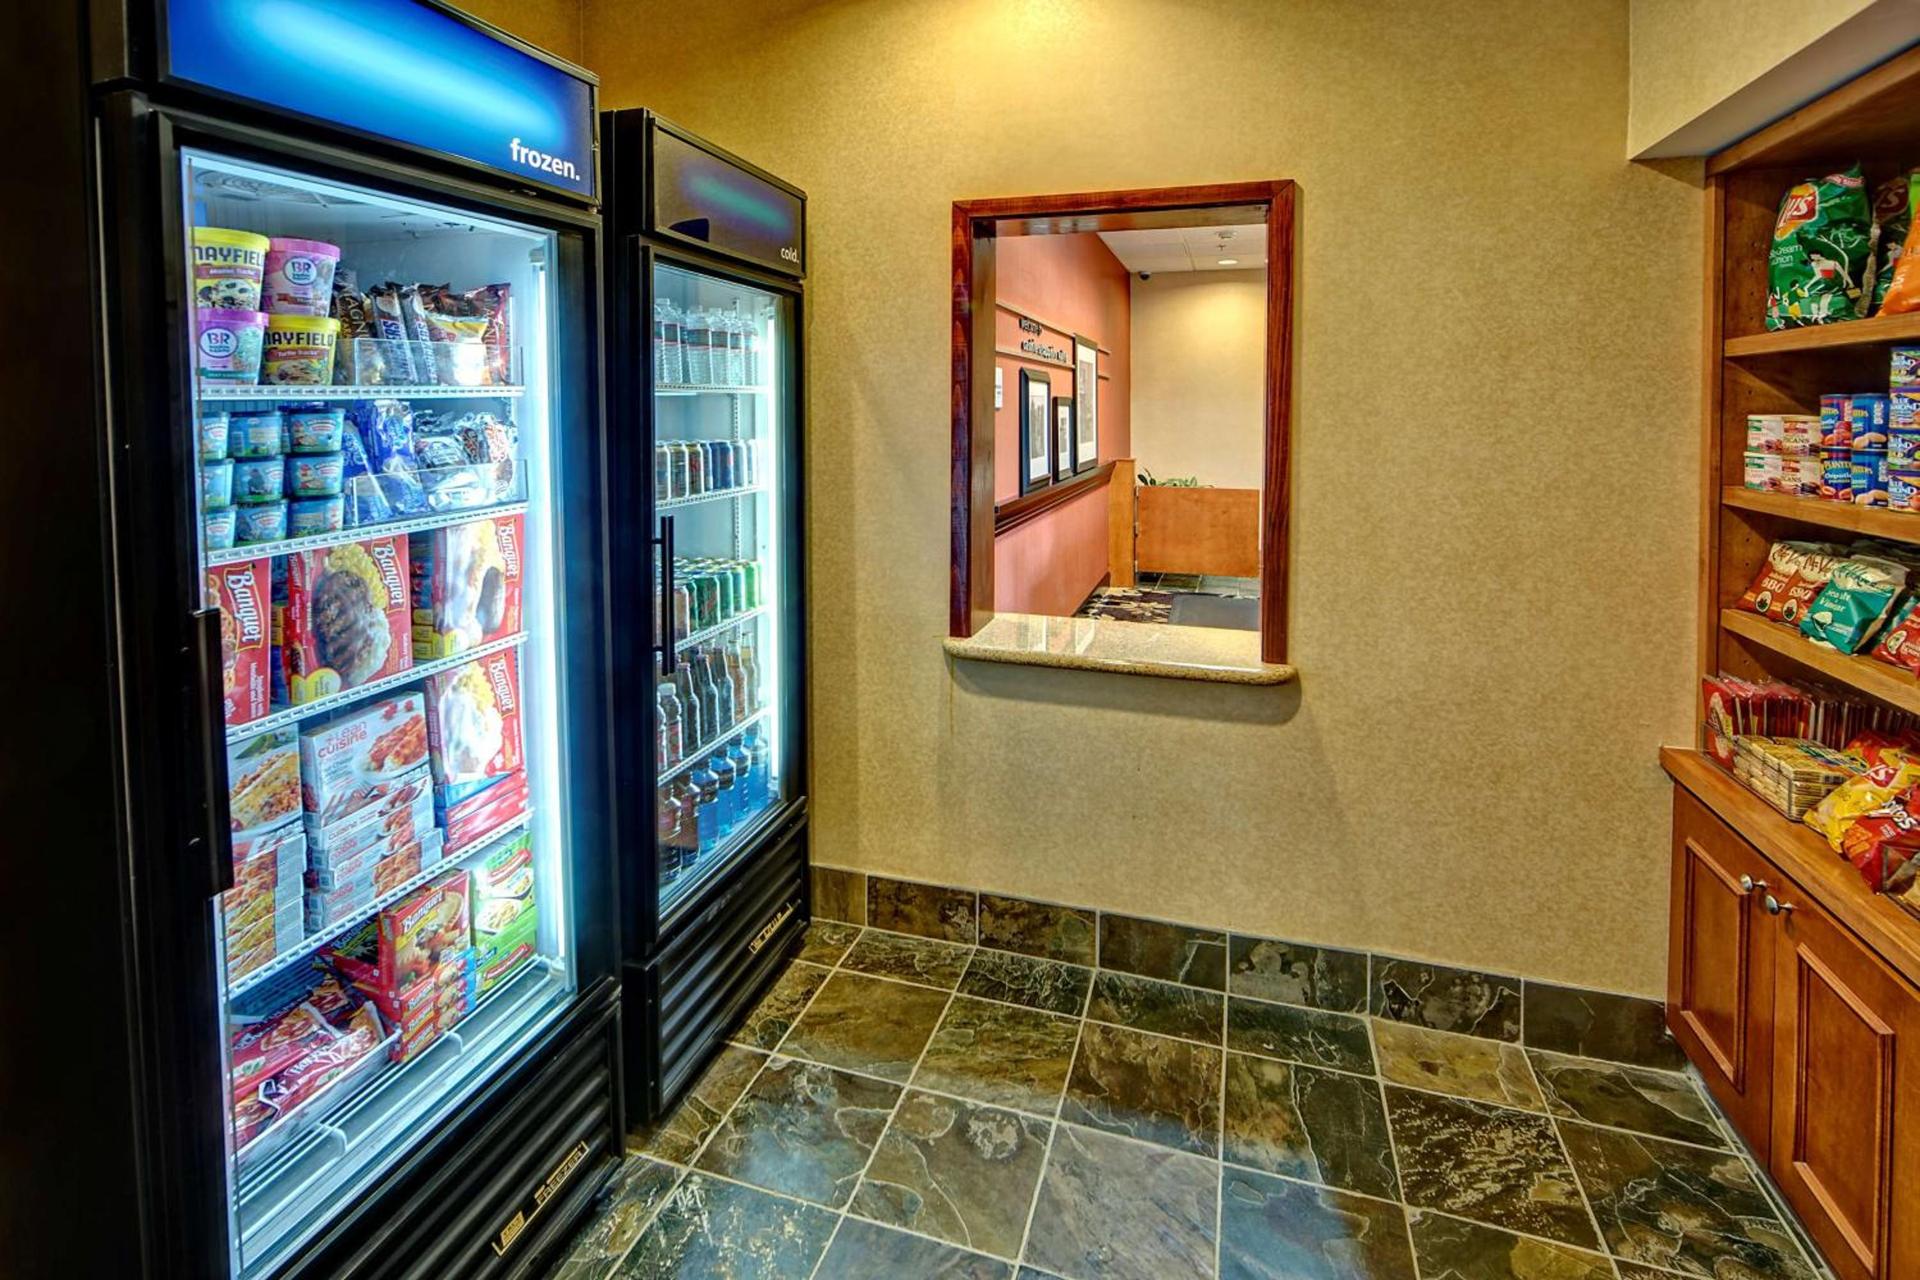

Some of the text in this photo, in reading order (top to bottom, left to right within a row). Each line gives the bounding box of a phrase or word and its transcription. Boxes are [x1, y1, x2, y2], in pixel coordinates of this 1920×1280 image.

[510, 137, 580, 180] frozen.
[193, 246, 264, 267] MAYFIEL
[292, 261, 312, 273] BR
[780, 247, 800, 264] cold.
[207, 333, 230, 344] BR
[500, 524, 517, 578] Banquet
[373, 543, 405, 606] Banquet
[227, 570, 262, 642] Banquet
[489, 658, 513, 712] Banquet
[403, 891, 443, 931] Banquet
[536, 1150, 582, 1205] FREEZER
